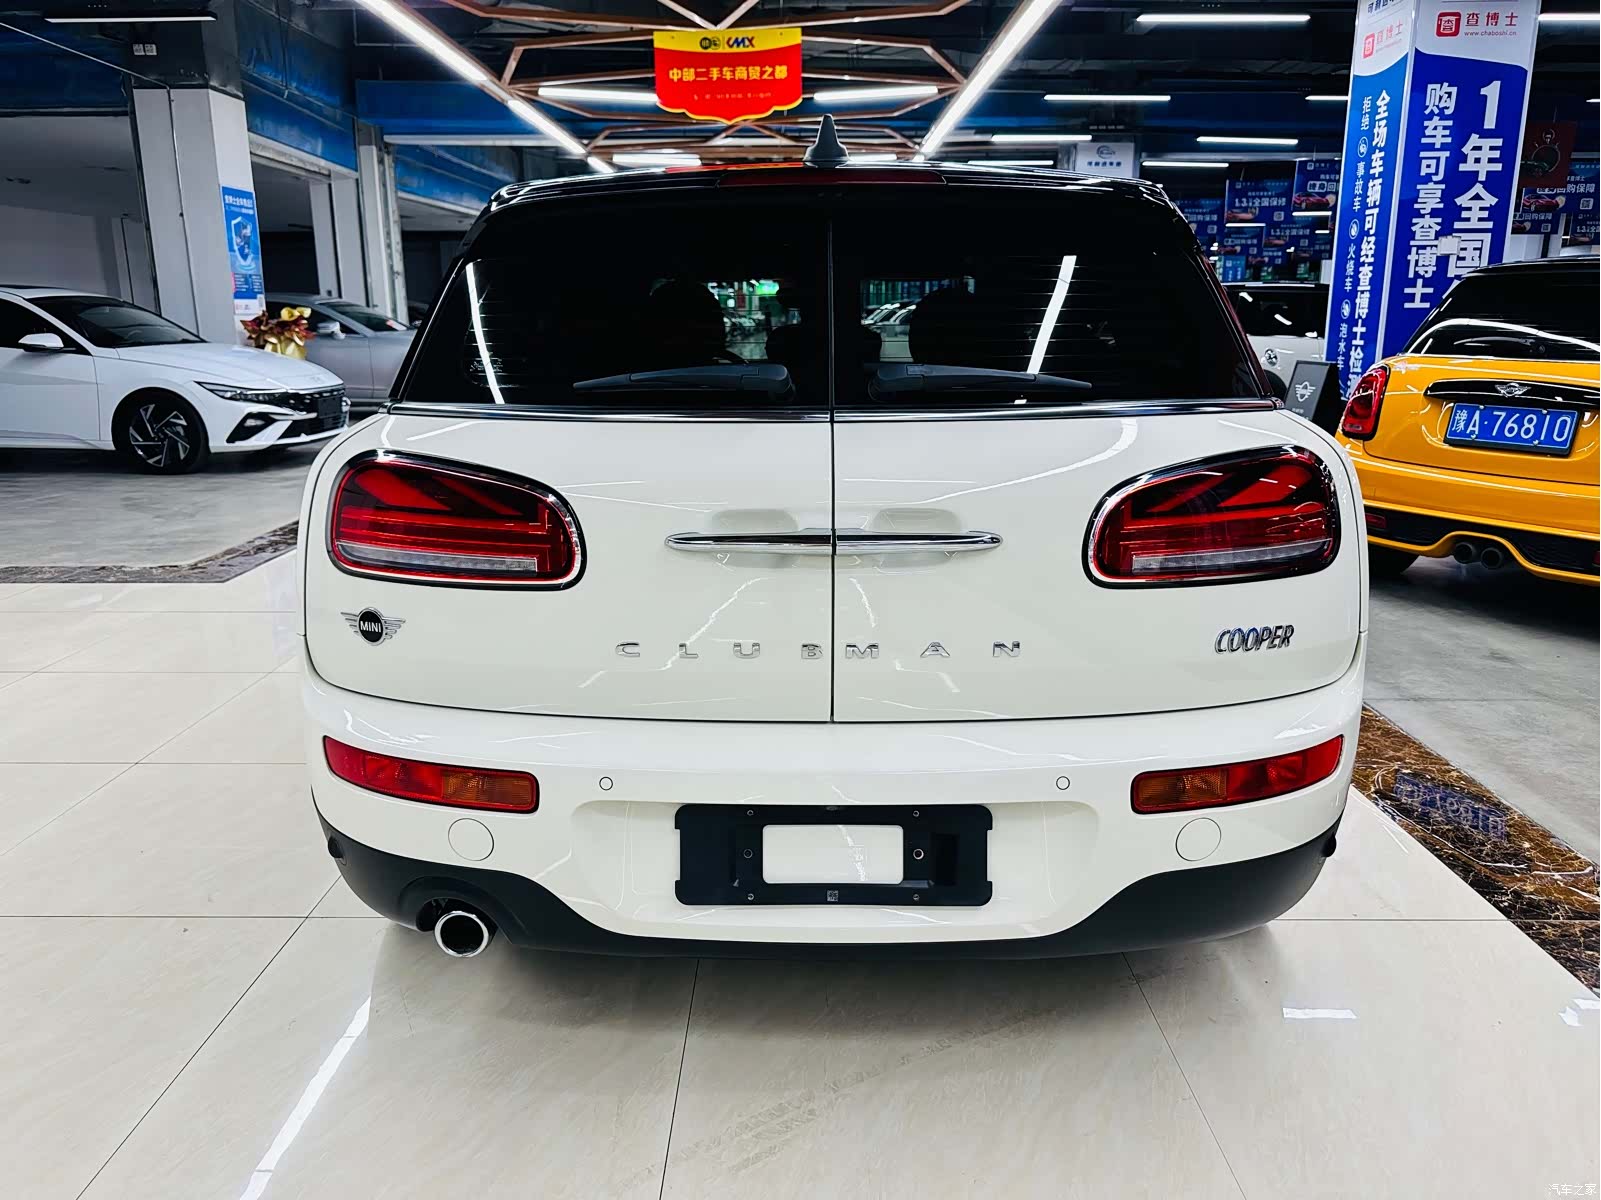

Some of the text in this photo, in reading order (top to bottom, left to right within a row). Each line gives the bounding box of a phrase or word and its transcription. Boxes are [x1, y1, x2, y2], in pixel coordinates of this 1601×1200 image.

[1465, 12, 1518, 27] 查博士
[668, 65, 788, 82] 中部二手车商贸之都
[1403, 82, 1458, 309] 购车可享查博士
[1441, 80, 1504, 300] 1年全国
[1336, 96, 1372, 369] 拒绝 事故车 火烧车 泡水车
[360, 620, 382, 633] MINI
[1214, 624, 1295, 654] COOPER
